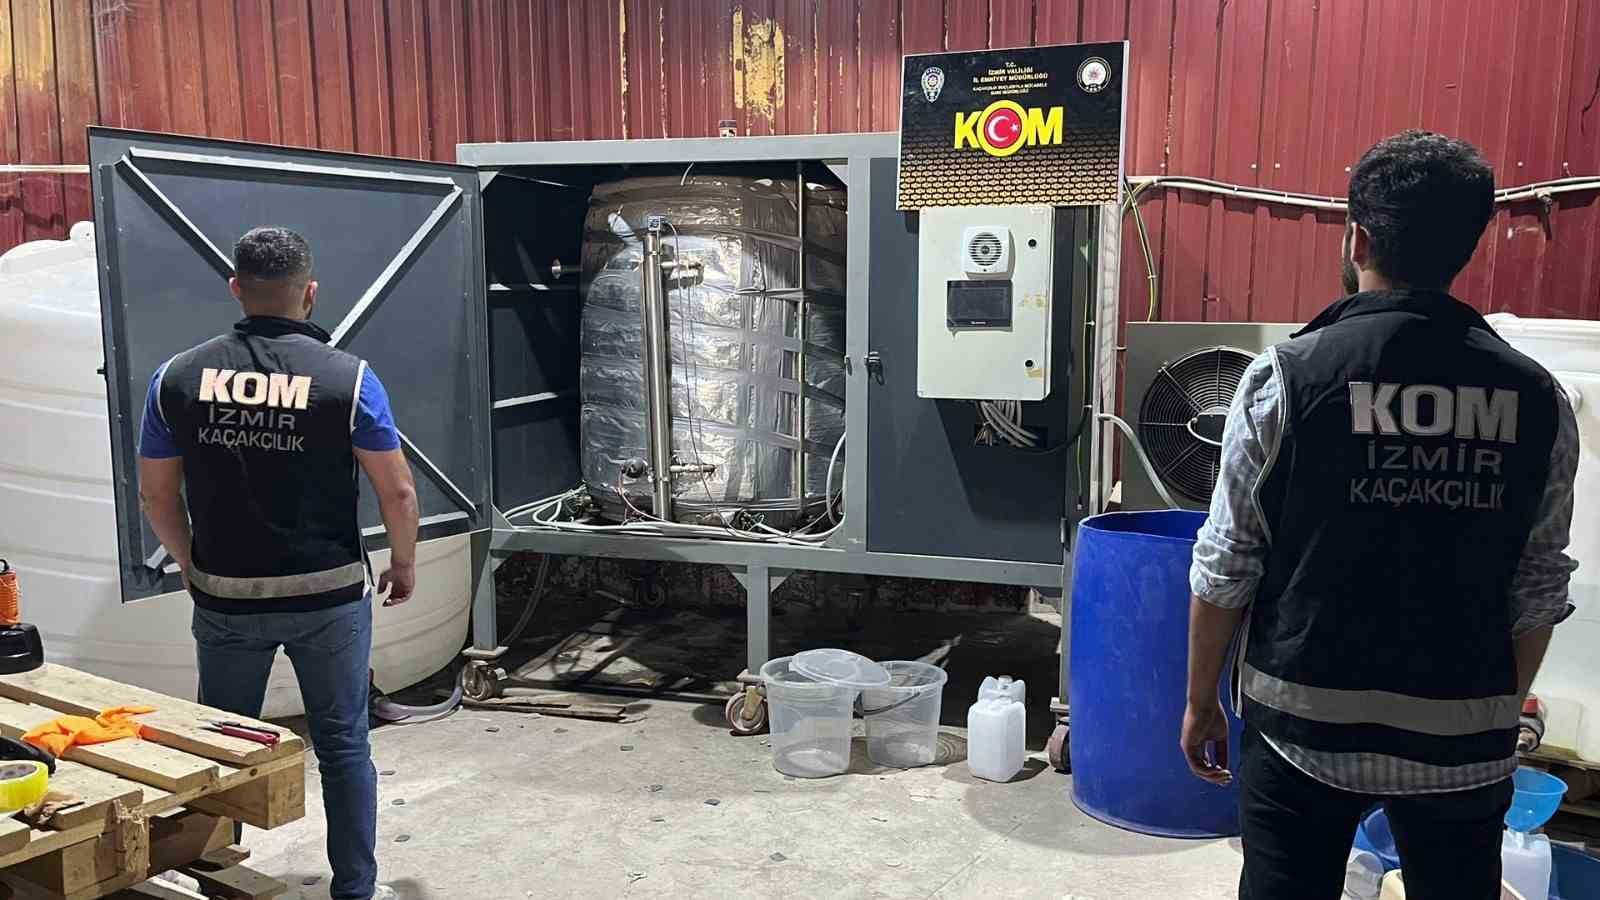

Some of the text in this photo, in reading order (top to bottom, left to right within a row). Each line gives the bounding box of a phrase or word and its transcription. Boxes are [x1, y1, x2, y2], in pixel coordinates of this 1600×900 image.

[954, 100, 1063, 157] KOM
[199, 367, 312, 410] KOM
[209, 404, 295, 430] İZMİR
[1349, 381, 1519, 443] KOM
[198, 427, 304, 452] KAÇAKÇILIK
[1368, 440, 1503, 474] İZMİR
[1350, 478, 1505, 512] KAÇAKÇILIK
